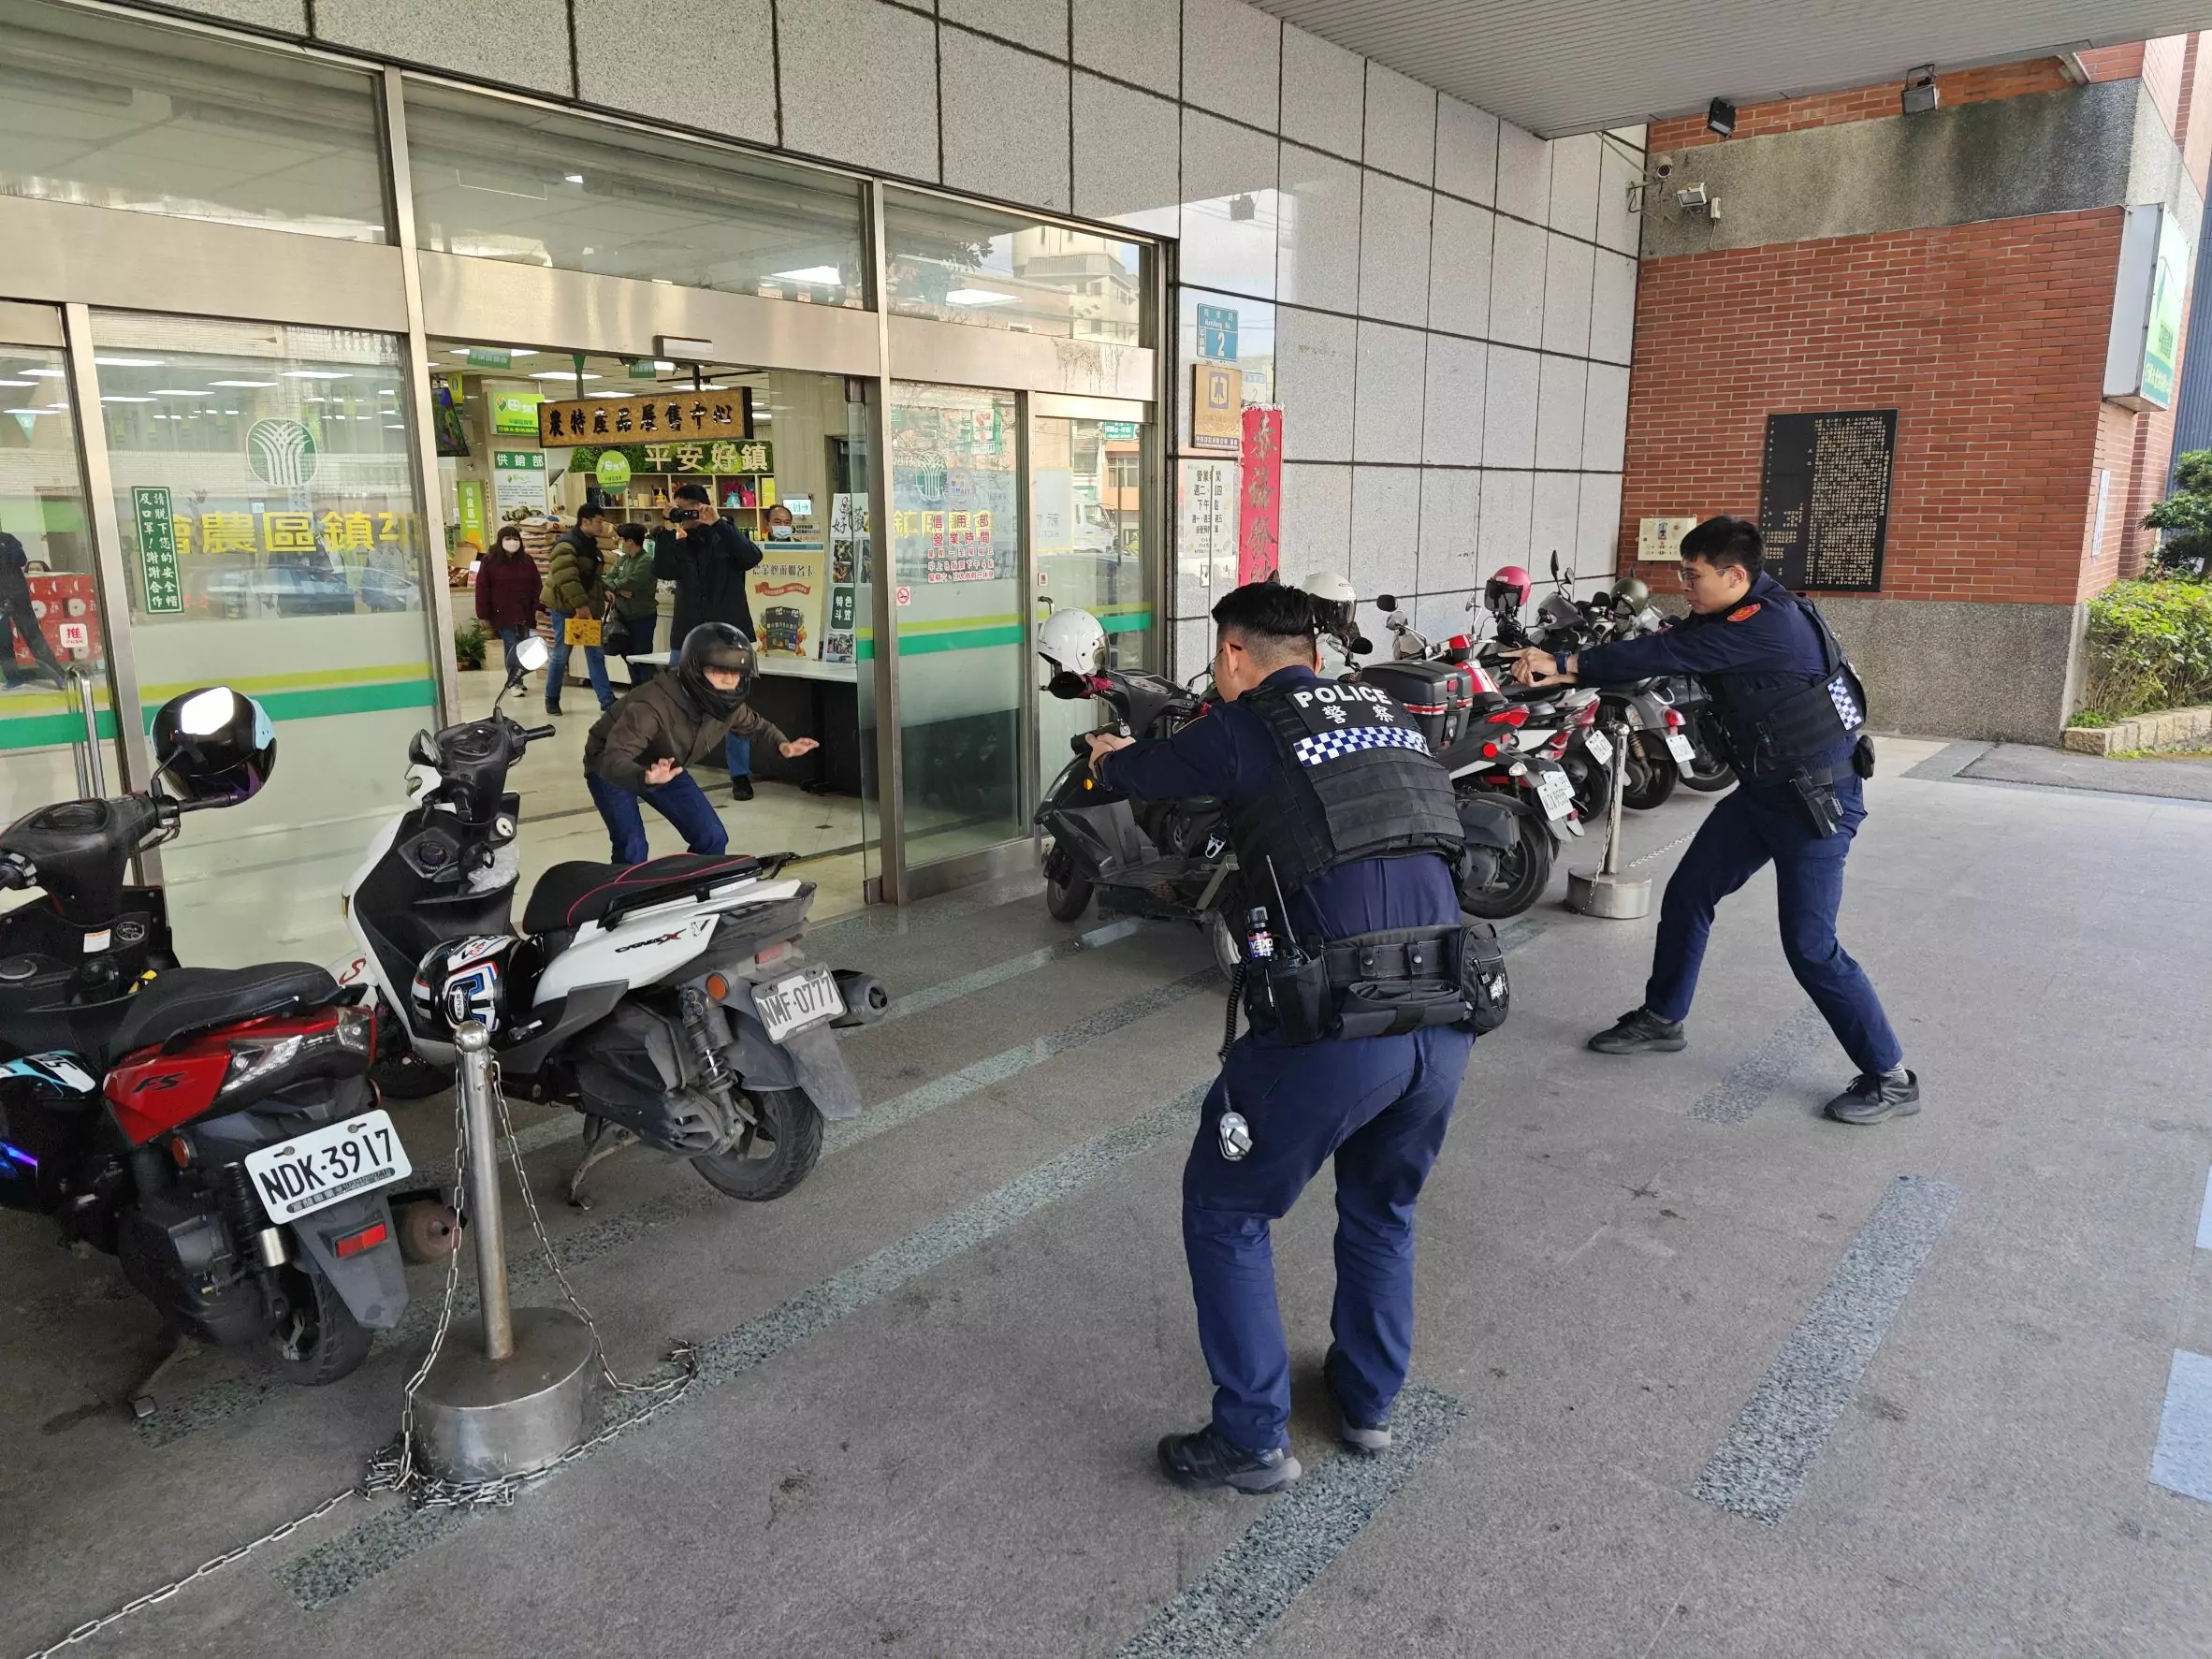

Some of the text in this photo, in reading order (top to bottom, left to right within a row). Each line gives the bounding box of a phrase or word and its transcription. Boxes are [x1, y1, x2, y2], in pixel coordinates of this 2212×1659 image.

[1217, 331, 1225, 357] 2
[548, 400, 733, 437] 農特產品展售中心
[497, 453, 545, 468] 供銷部
[644, 443, 769, 472] 平安好鎮
[933, 514, 989, 529] 信用部
[153, 492, 179, 607] 請脫下您的安全帽
[933, 531, 990, 547] 營業時間
[835, 595, 852, 608] 特色
[834, 609, 851, 621] 斗笠
[66, 627, 81, 639] 推
[1293, 684, 1392, 708] POLICE
[1322, 704, 1394, 724] 警察
[757, 976, 834, 1029] NMF-0777
[132, 1072, 186, 1093] FS
[258, 1128, 393, 1205] NDK-3917
